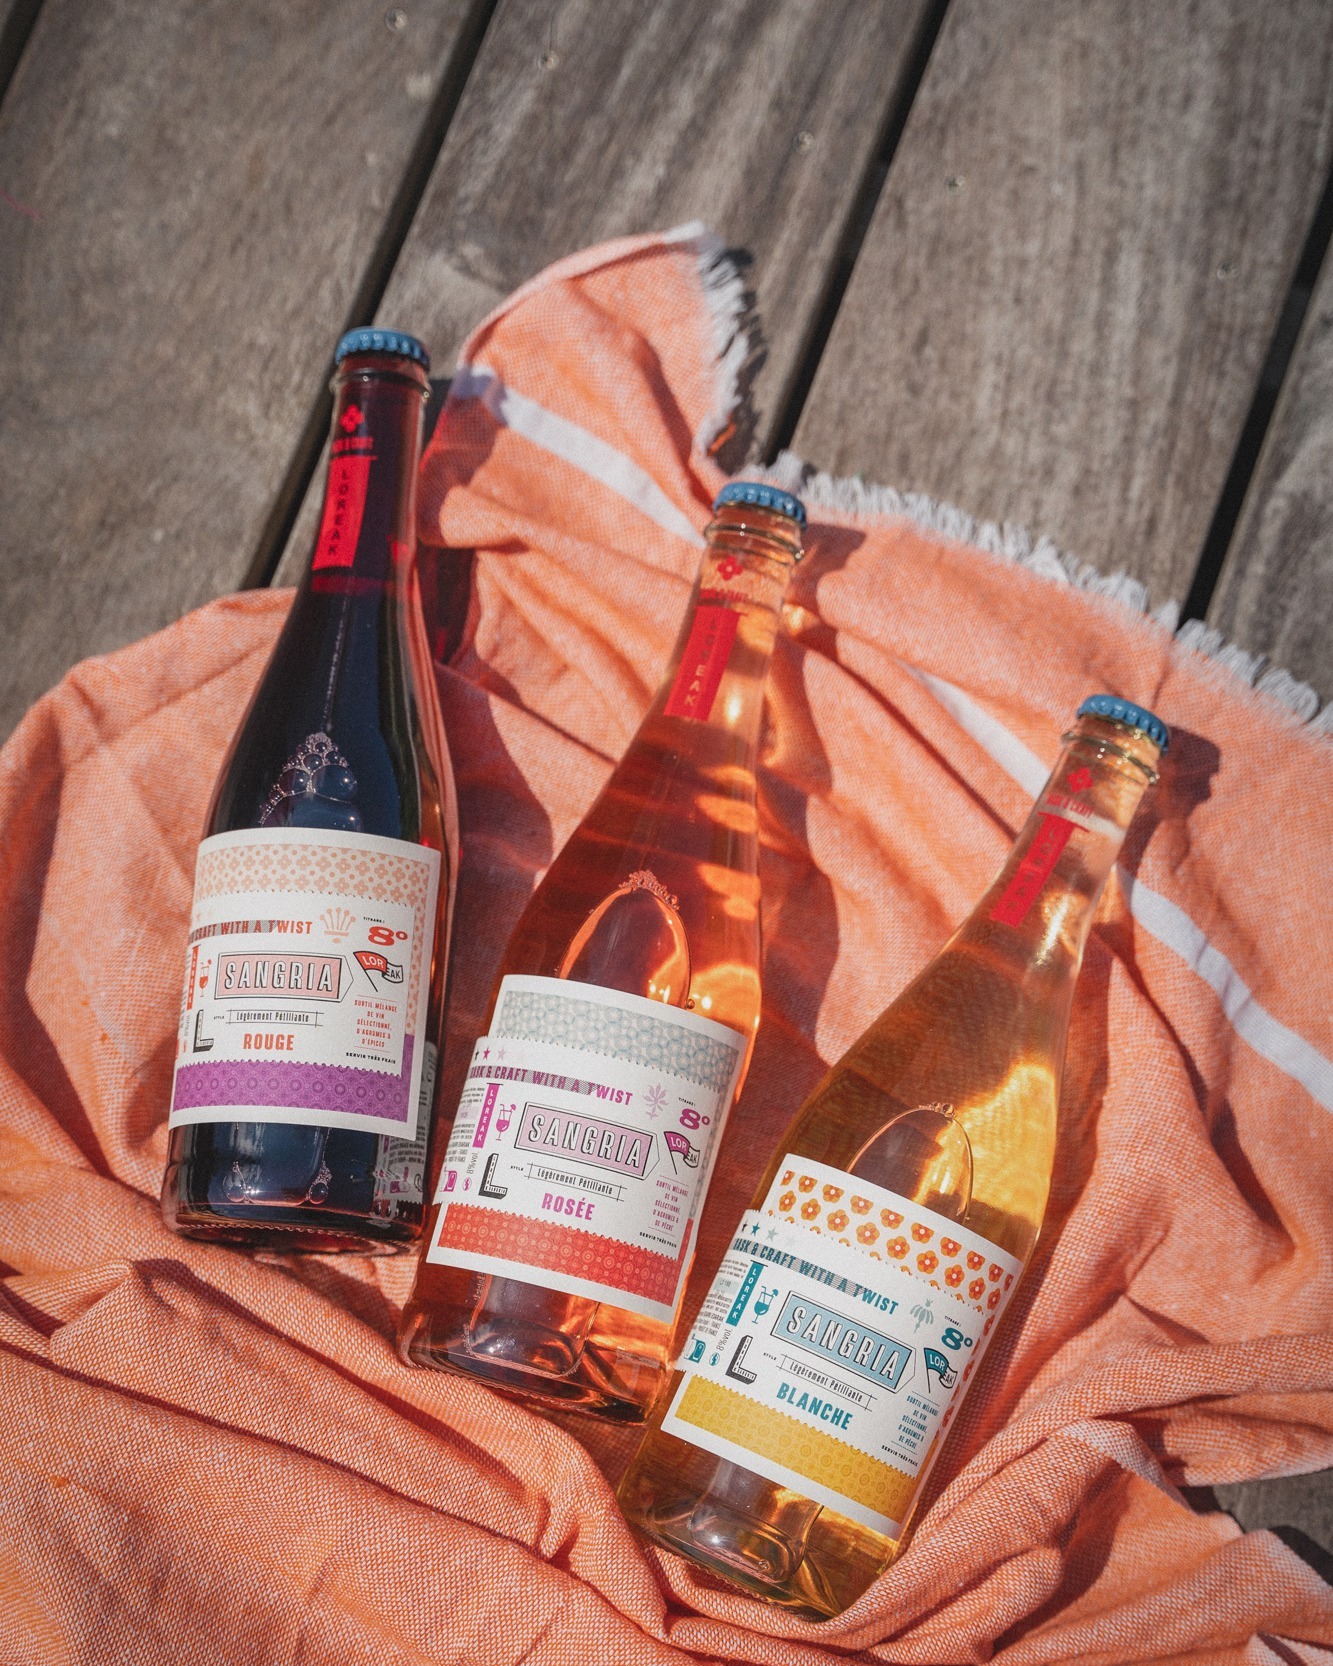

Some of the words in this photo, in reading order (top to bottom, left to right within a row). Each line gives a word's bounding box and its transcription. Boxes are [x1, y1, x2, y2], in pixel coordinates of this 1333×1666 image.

[221, 920, 249, 935] WITH
[253, 920, 262, 933] A
[268, 919, 313, 934] TWIST
[224, 960, 333, 993] SANGRIA
[361, 955, 384, 969] LOR
[386, 966, 401, 980] EAK
[236, 1010, 273, 1023] Légèrement
[275, 1011, 310, 1023] Pétillante
[354, 999, 373, 1009] SUBTIL
[366, 1011, 376, 1019] DE
[376, 1011, 385, 1020] VIN
[242, 1033, 295, 1051] ROUGE
[486, 1065, 493, 1078] &
[494, 1066, 529, 1083] CRAFT
[532, 1069, 567, 1090] WITH
[570, 1078, 580, 1093] A
[587, 1081, 633, 1106] TWIST
[476, 1089, 494, 1142] LOREAK
[528, 1114, 643, 1169] SANGRIA
[670, 1136, 687, 1151] LOR
[537, 1167, 577, 1185] Légèrement
[578, 1176, 613, 1195] Pétillante
[541, 1192, 596, 1221] ROSÉE
[664, 1192, 671, 1200] DE
[751, 1243, 760, 1255] &
[760, 1245, 798, 1269] CRAFT
[799, 1259, 836, 1286] WITH
[836, 1278, 848, 1293] A
[852, 1283, 899, 1316] TWIST
[732, 1268, 757, 1320] LOREAK
[786, 1305, 901, 1381] SANGRIA
[929, 1353, 945, 1372] LOR
[789, 1361, 829, 1387] Légèrement
[829, 1379, 863, 1403] Pétillante
[775, 1382, 854, 1431] BLANCHE
[912, 1409, 919, 1417] DE
